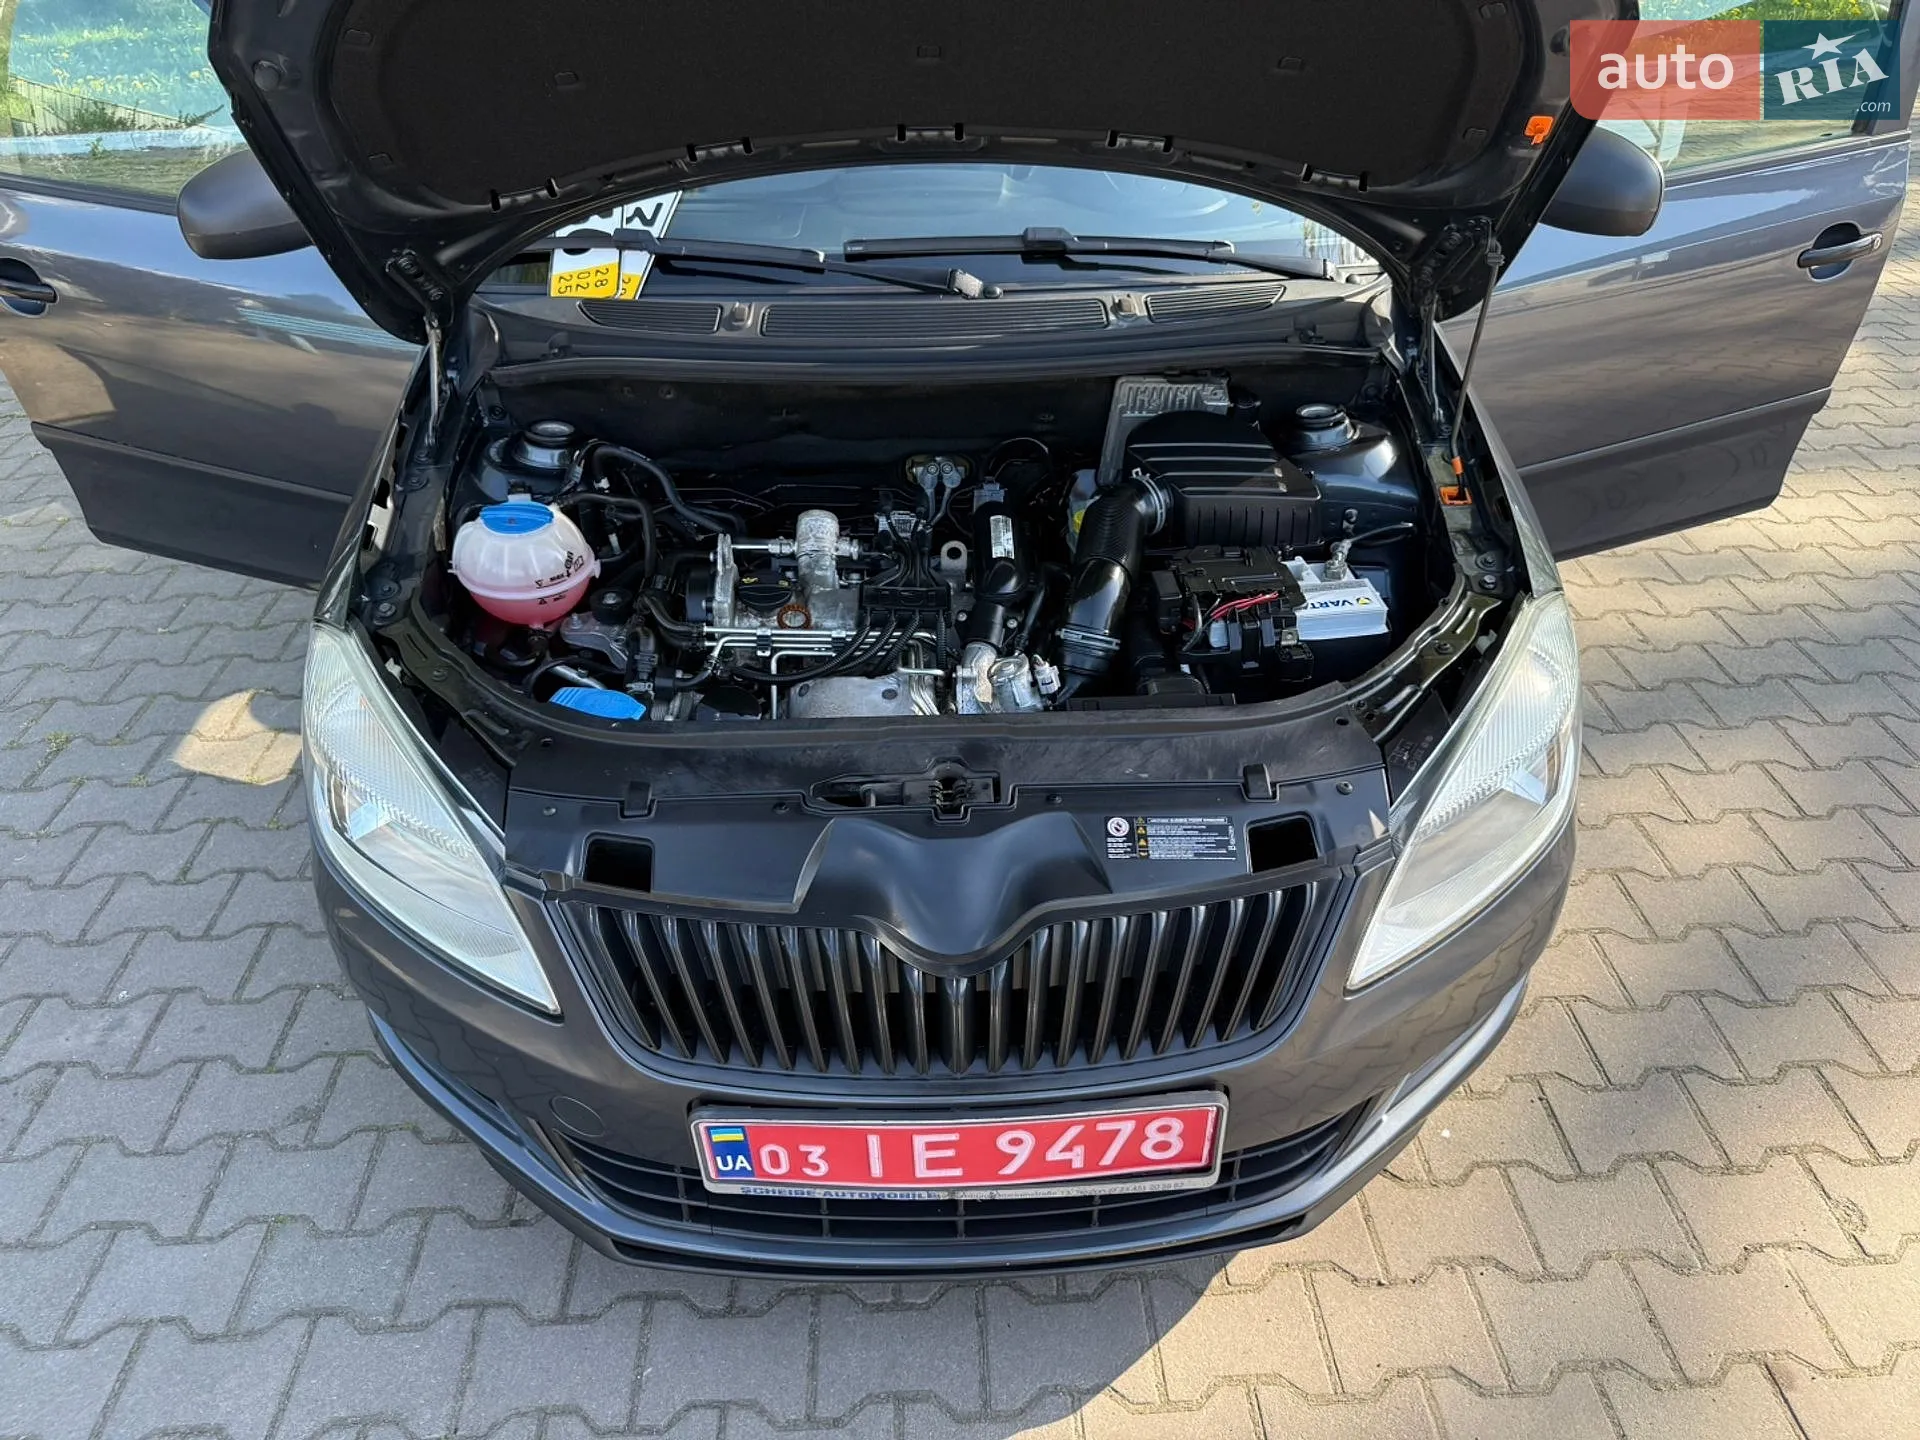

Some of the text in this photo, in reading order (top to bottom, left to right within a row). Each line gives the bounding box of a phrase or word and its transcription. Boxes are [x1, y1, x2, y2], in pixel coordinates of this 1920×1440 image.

[558, 274, 573, 295] 25
[575, 271, 591, 291] 02
[595, 268, 610, 288] 28
[759, 1117, 1184, 1178] 03 IE 9478
[716, 1156, 751, 1170] UA
